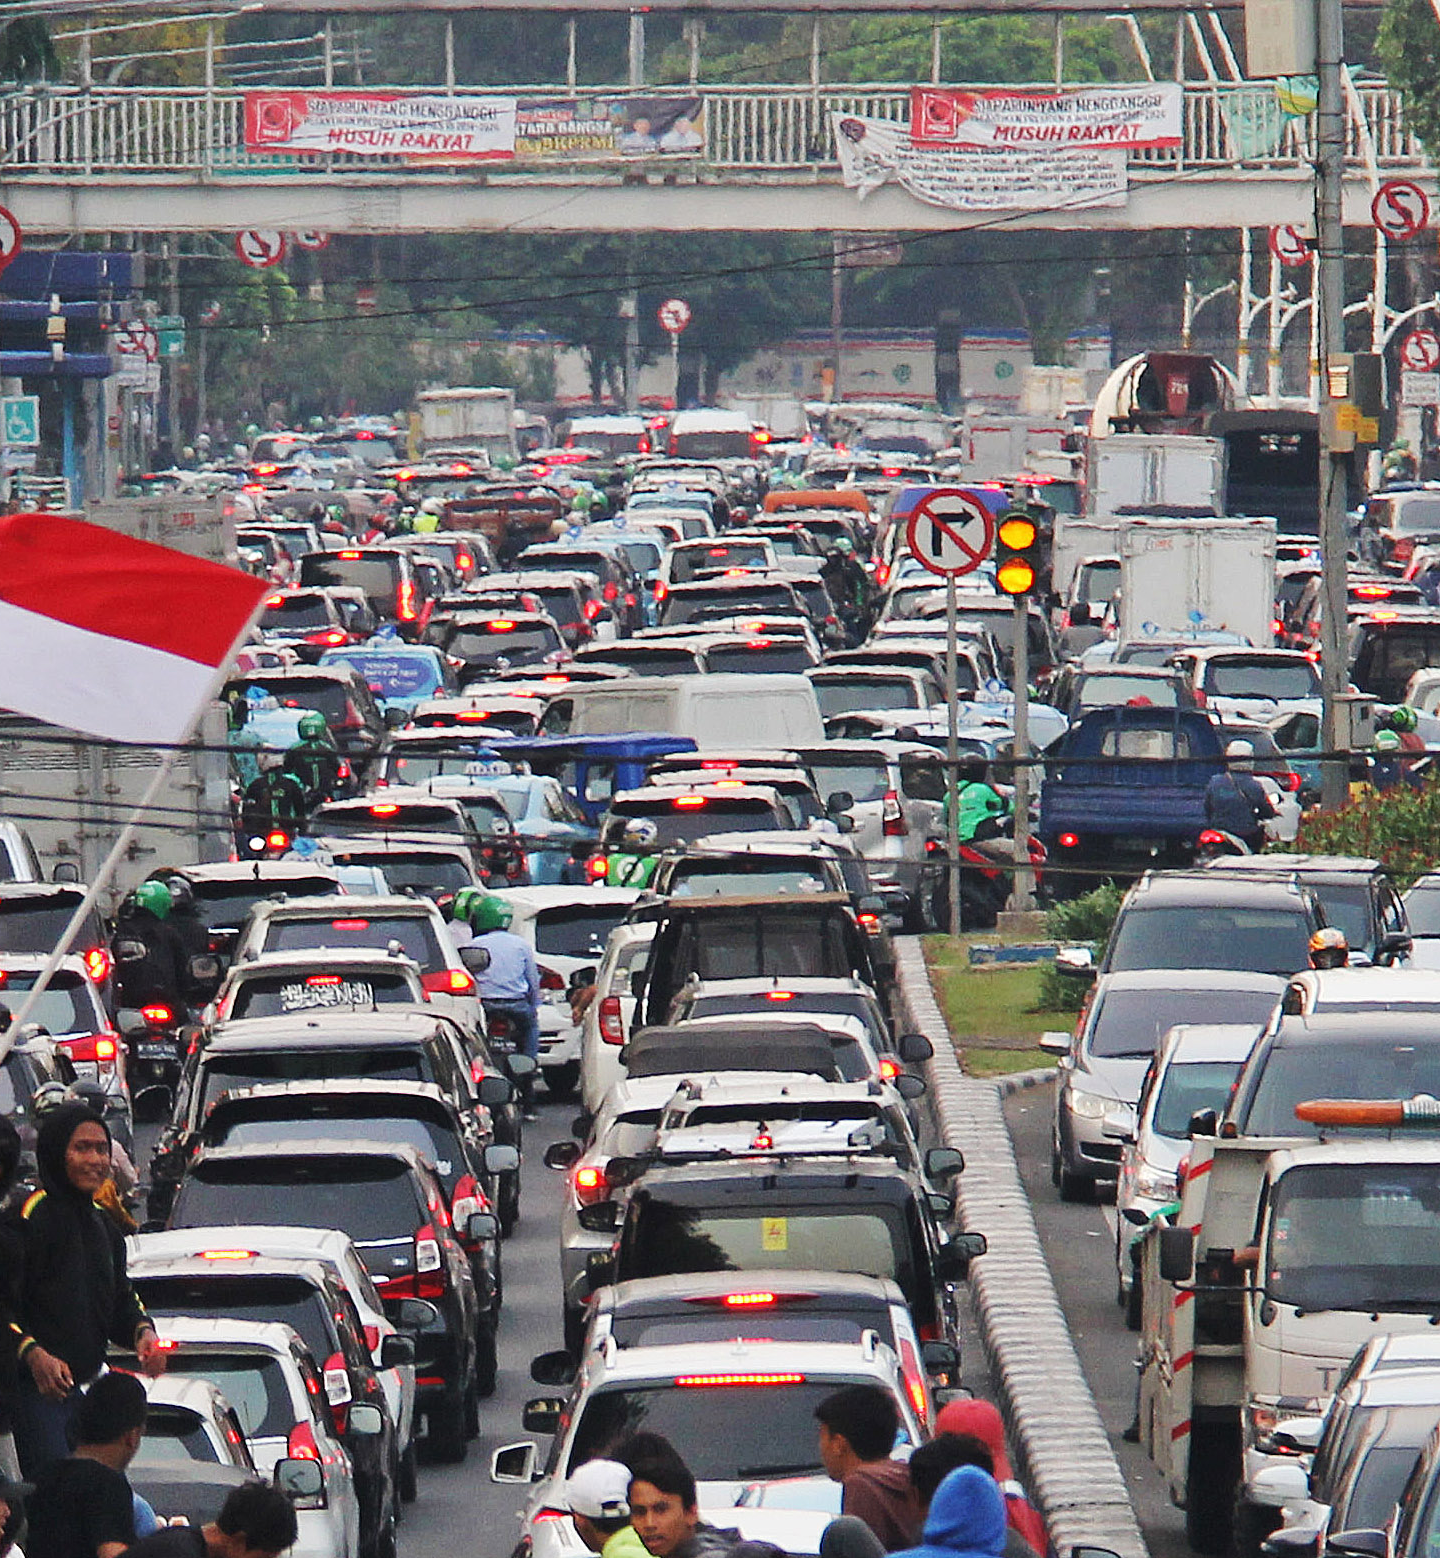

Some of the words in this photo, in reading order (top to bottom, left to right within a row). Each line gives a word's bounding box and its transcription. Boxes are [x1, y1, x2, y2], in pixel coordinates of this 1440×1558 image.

[328, 128, 396, 146] MUSUH
[400, 131, 475, 150] RAKYAT
[993, 126, 1062, 141] MUSUH
[1067, 124, 1142, 140] RAKYAT
